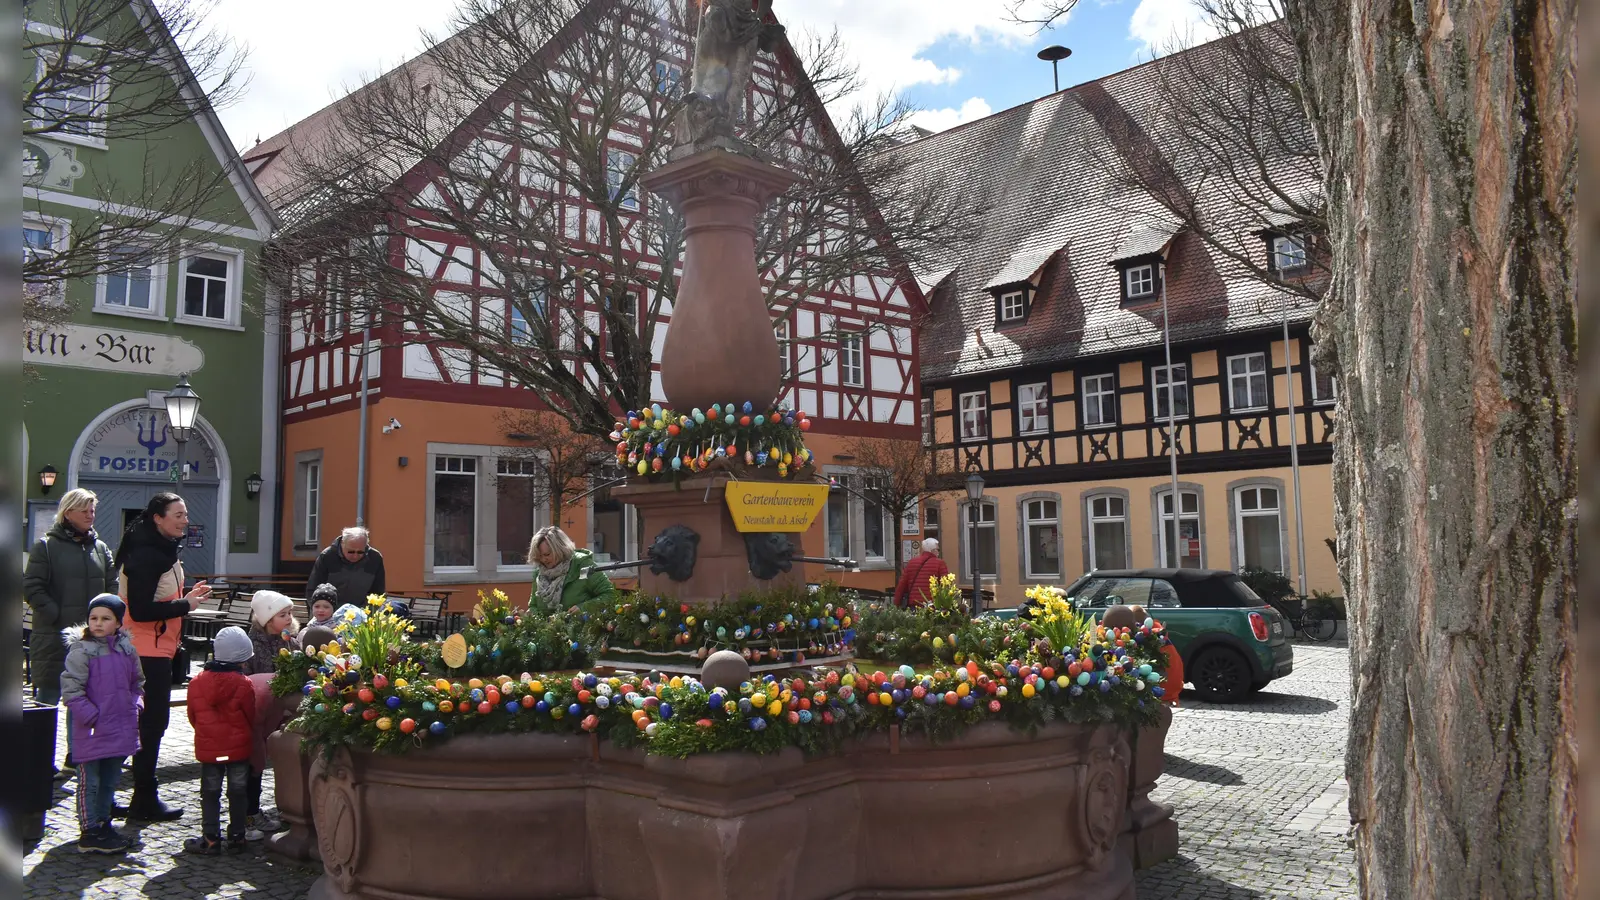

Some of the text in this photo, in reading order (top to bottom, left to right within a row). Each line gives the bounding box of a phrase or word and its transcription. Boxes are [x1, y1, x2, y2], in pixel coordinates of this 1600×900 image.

[94, 332, 156, 365] Bar
[81, 411, 144, 467] GRIECHISCHES
[98, 456, 199, 474] POSEIDN
[742, 489, 815, 506] Gartenbauverein
[743, 514, 775, 525] Neustadt
[789, 512, 808, 526] Aisch
